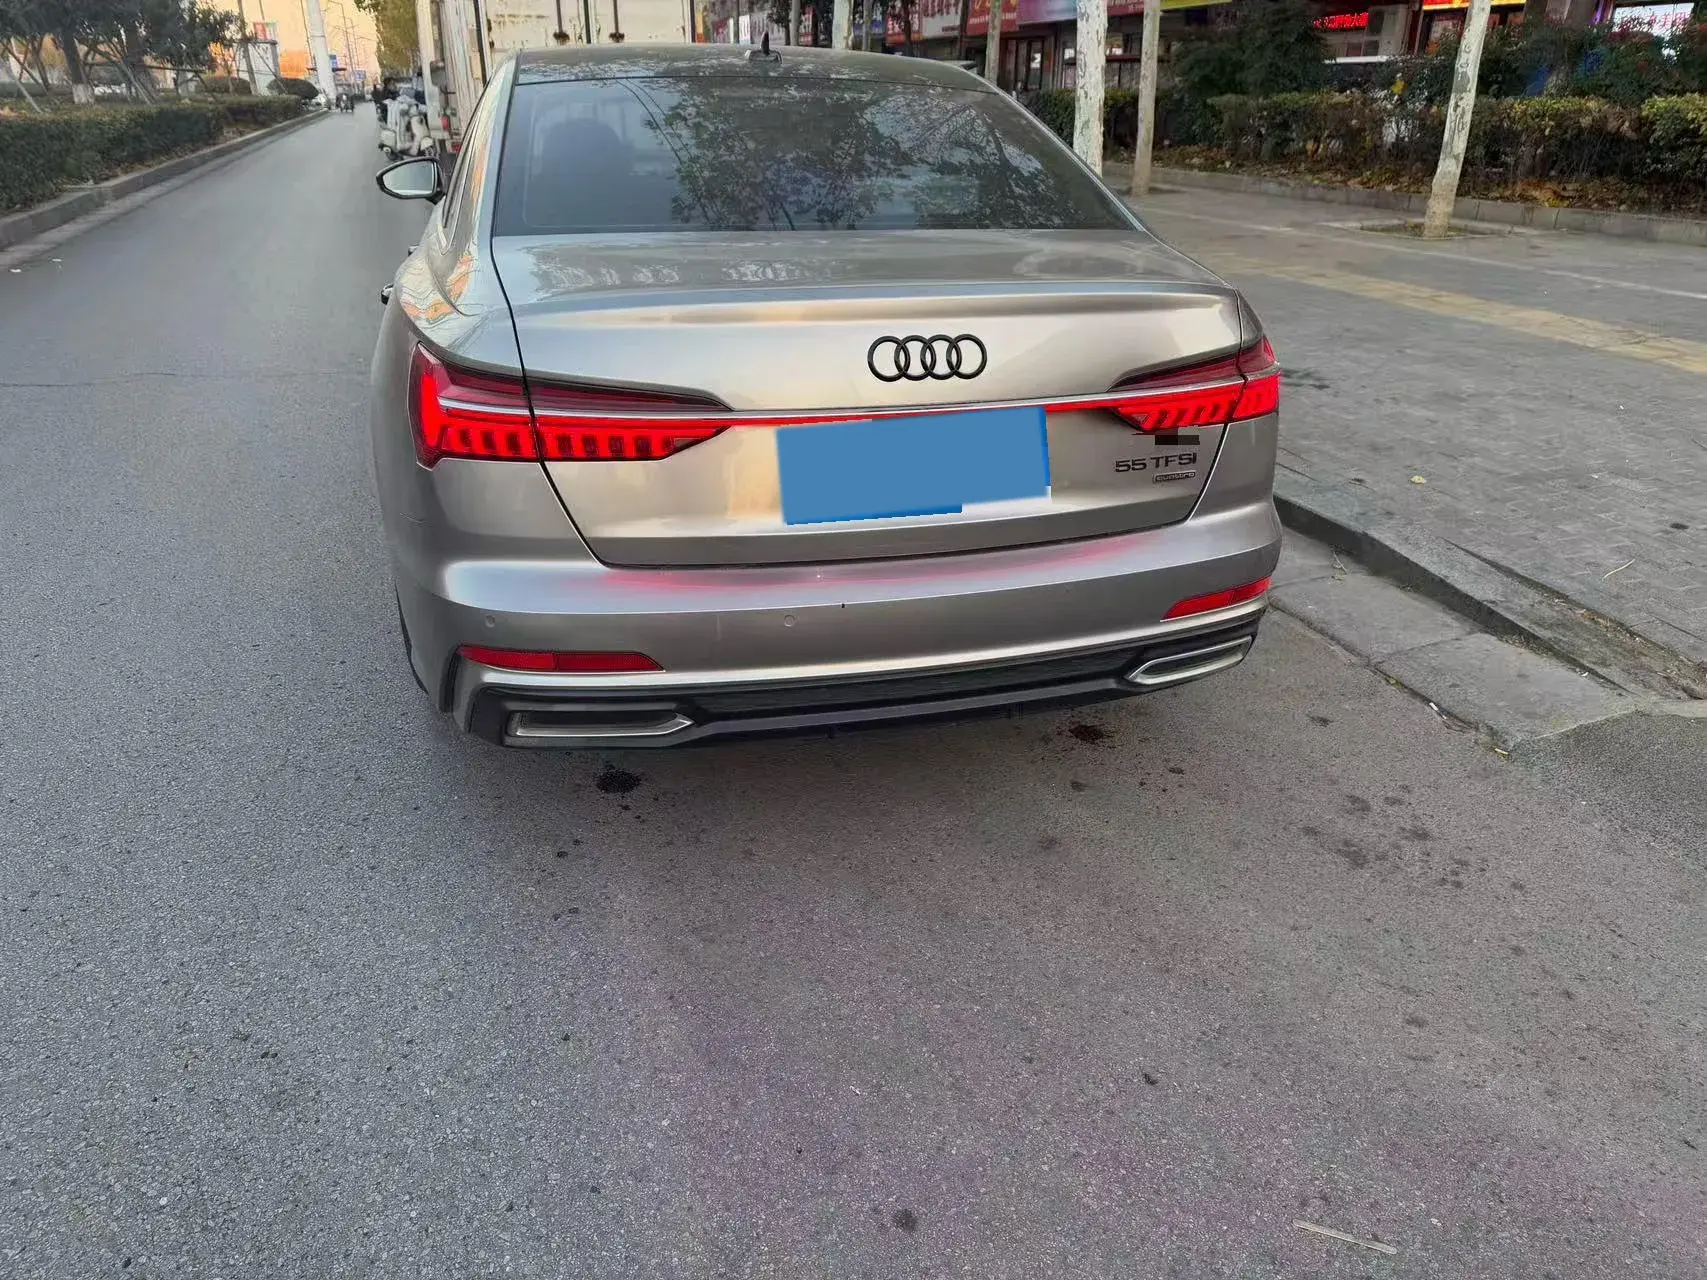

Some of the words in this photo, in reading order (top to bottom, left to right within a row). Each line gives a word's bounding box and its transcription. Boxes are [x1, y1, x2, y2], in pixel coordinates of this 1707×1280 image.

[1115, 458, 1147, 473] 55
[1150, 452, 1197, 468] TFSI
[1156, 472, 1195, 481] quattro
